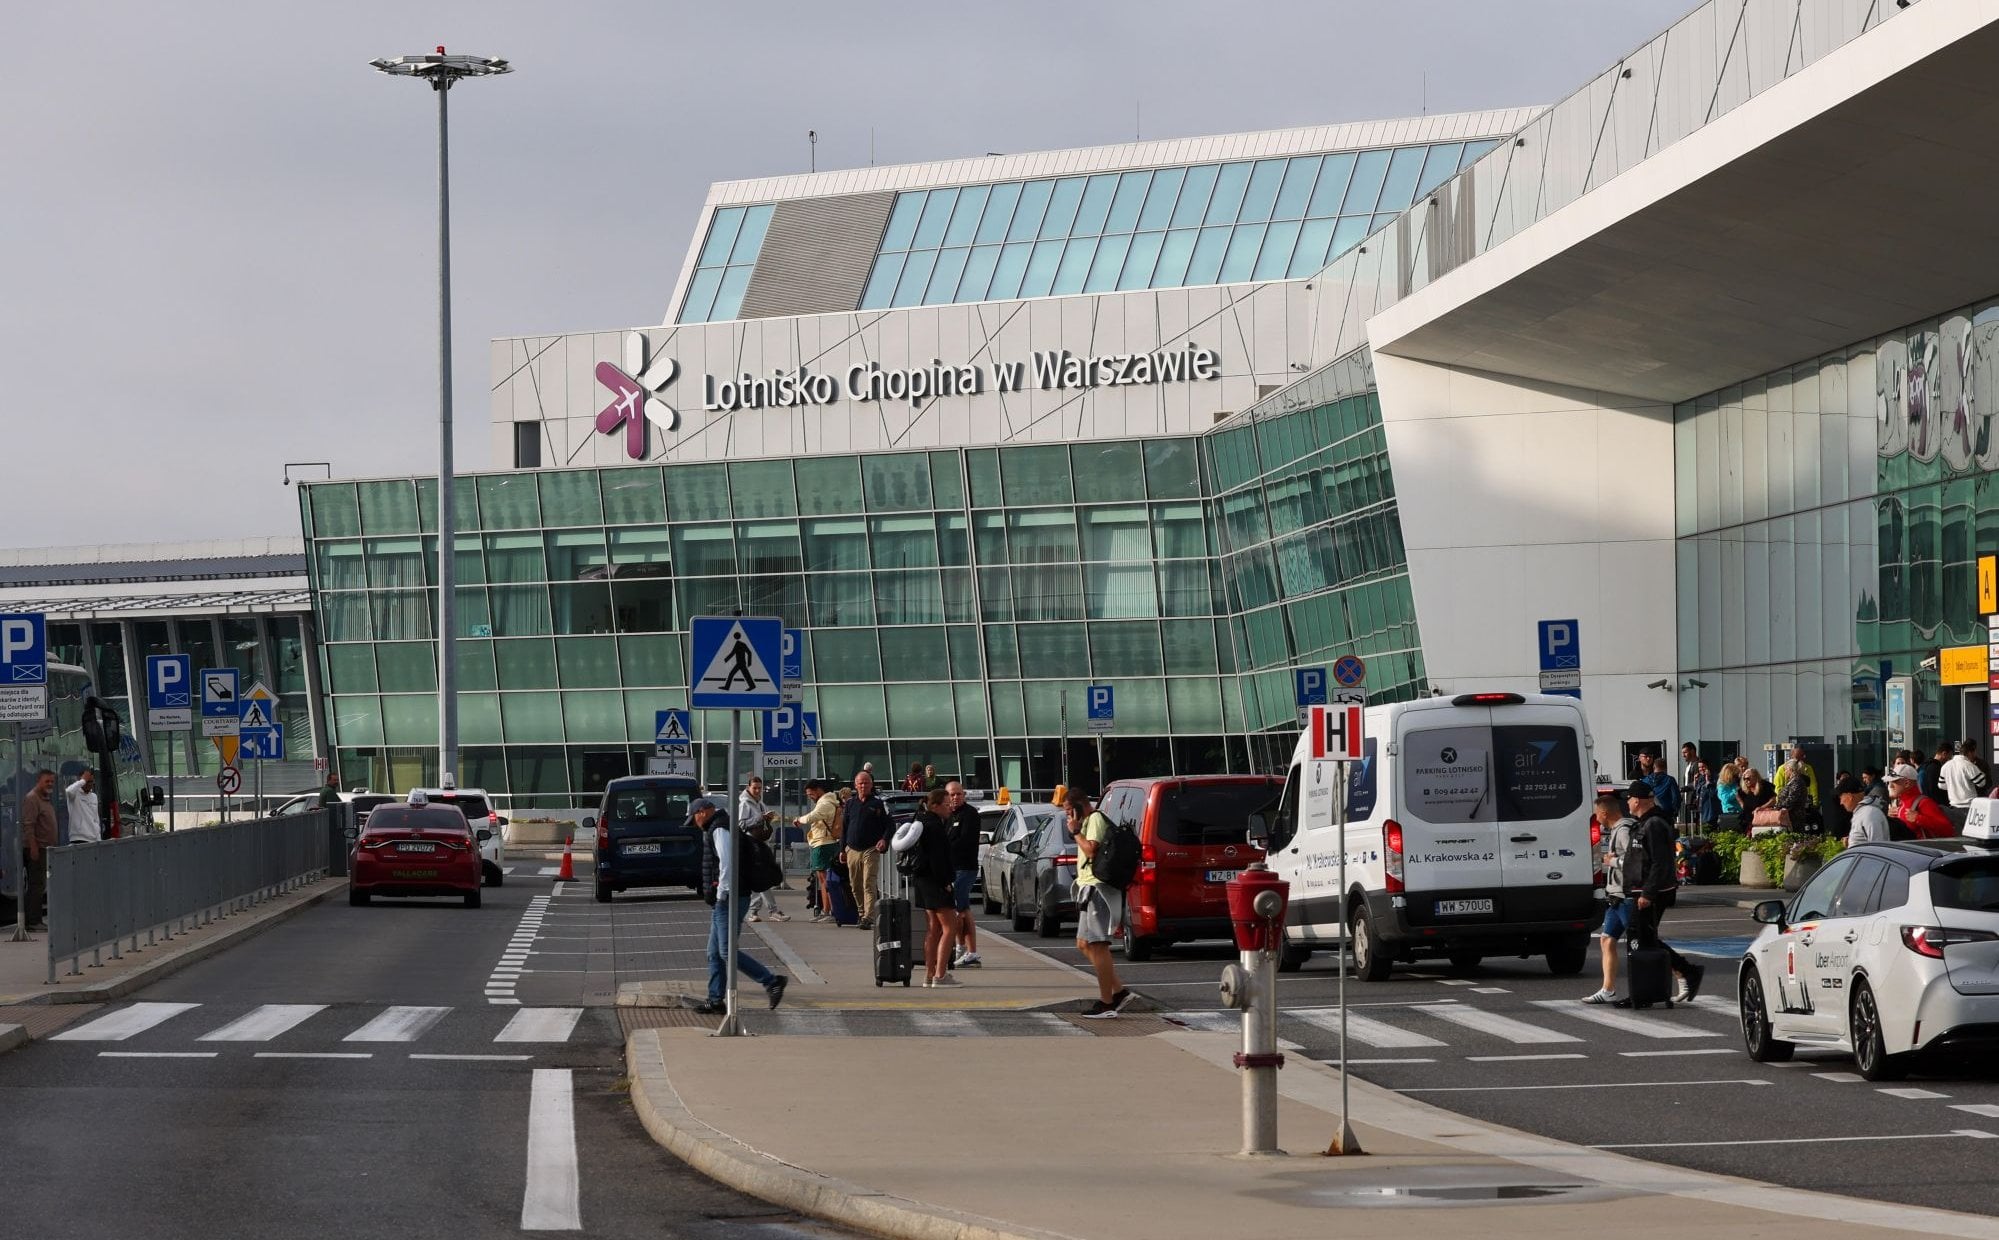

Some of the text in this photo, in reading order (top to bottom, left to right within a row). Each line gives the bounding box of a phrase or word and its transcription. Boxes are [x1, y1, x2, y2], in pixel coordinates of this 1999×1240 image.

[702, 342, 1219, 412] Lotnisko Chopina w Warszawie
[1984, 569, 1990, 600] A
[2, 620, 33, 663] P
[1547, 624, 1570, 655] P
[158, 660, 181, 692] P
[1303, 672, 1320, 695] P
[1093, 688, 1109, 709] P
[772, 707, 794, 738] P
[1326, 712, 1346, 752] H
[767, 756, 798, 766] Koniec
[1515, 749, 1537, 768] air
[1416, 765, 1483, 775] PARKING LOTNISKO
[1434, 788, 1448, 796] 609
[1968, 807, 1986, 828] Uber
[1424, 852, 1480, 863] Krakowska
[1482, 852, 1495, 862] 42
[1211, 871, 1223, 881] WZ
[1441, 900, 1491, 913] WW 570UG
[1816, 950, 1849, 971] Uber Airport
